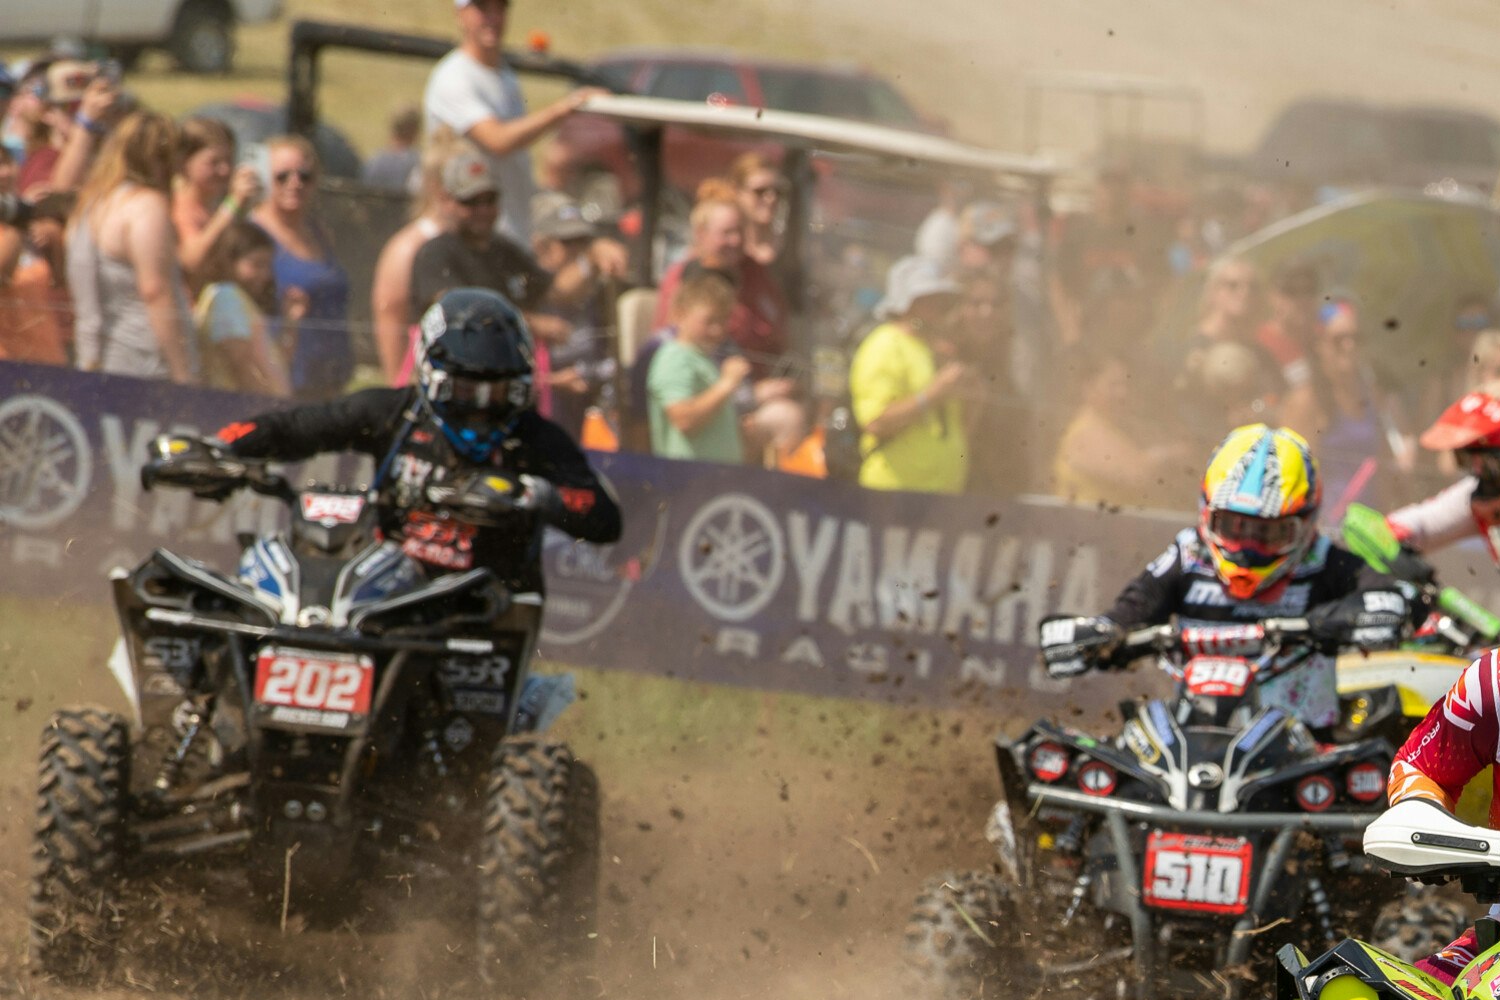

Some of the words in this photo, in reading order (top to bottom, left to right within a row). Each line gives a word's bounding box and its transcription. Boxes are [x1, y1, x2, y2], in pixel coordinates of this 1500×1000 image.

[786, 509, 1100, 648] YAMAHA
[262, 658, 364, 711] 202
[1189, 661, 1249, 687] 510
[1406, 721, 1440, 763] PRO-FIT
[1350, 771, 1382, 794] 510
[1152, 849, 1243, 905] 510
